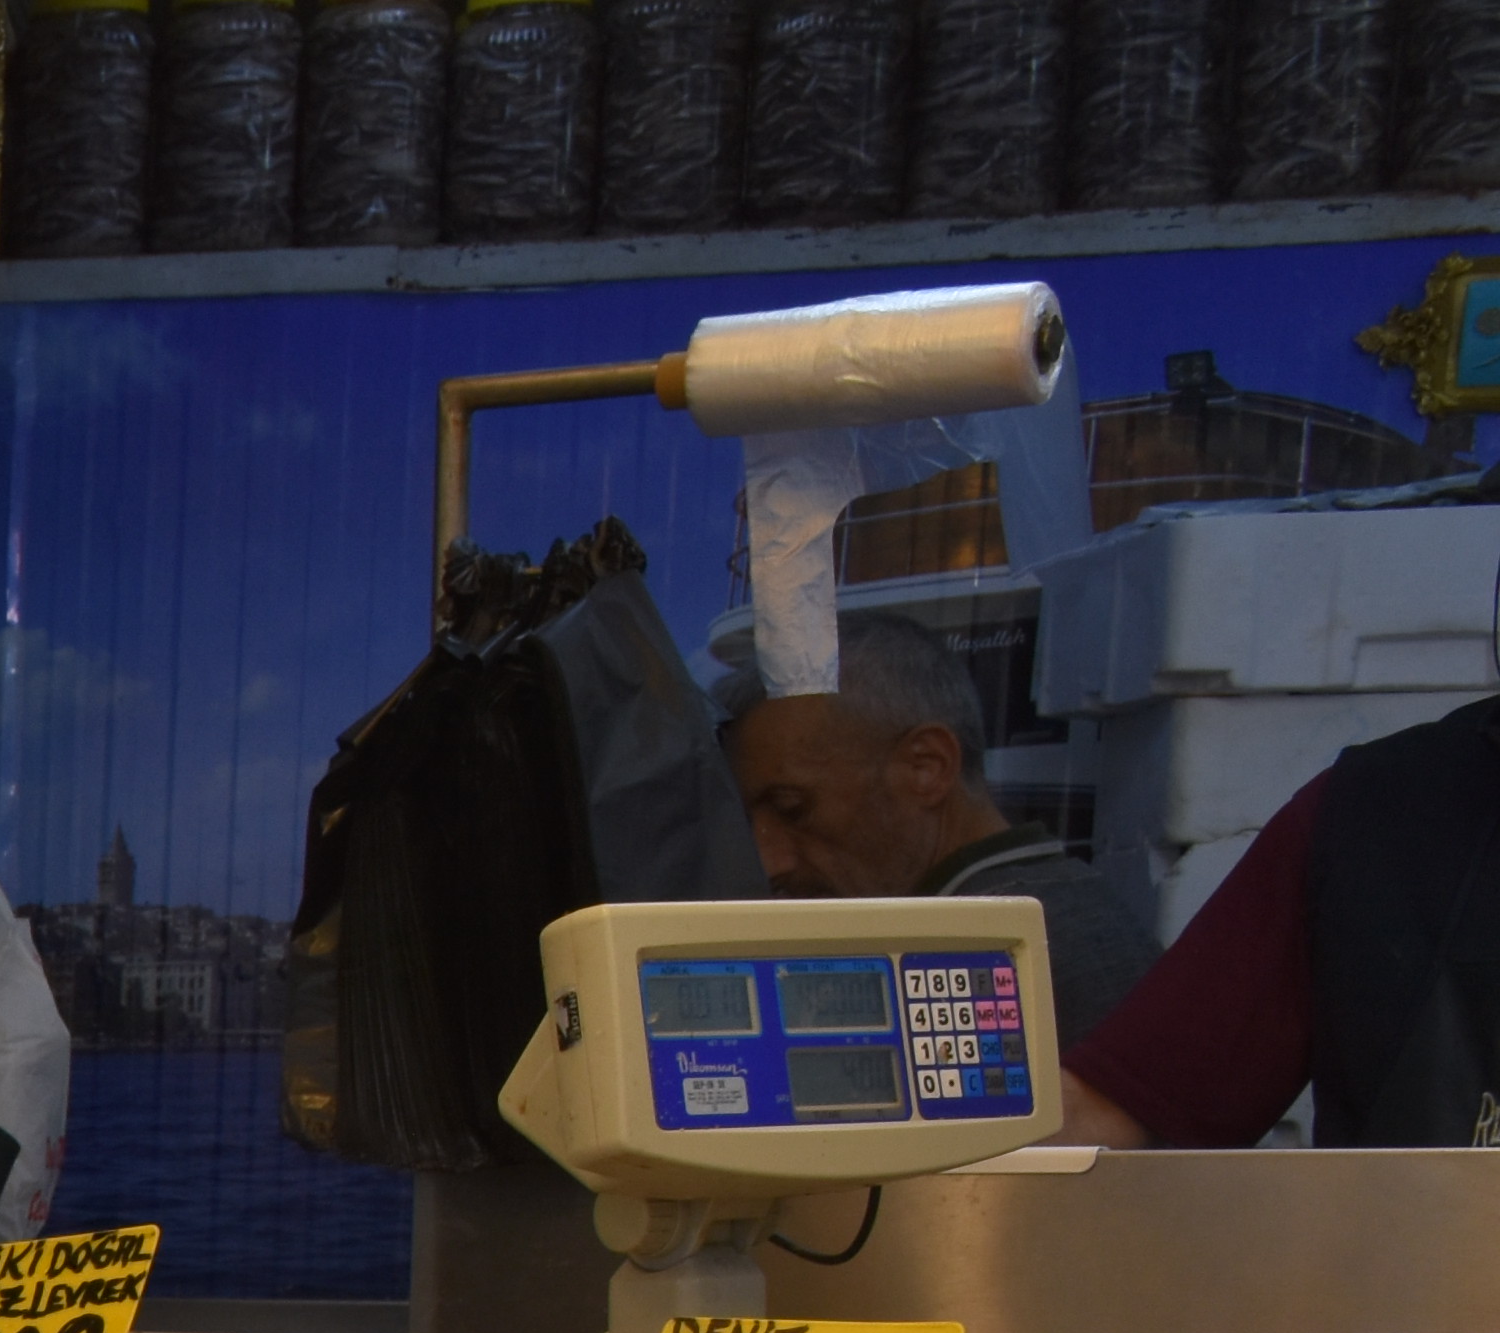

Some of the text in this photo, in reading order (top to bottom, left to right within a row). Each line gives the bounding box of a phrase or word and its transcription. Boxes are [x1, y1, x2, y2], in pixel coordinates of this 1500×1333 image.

[910, 975, 921, 993] 7
[932, 974, 945, 993] 8
[955, 974, 966, 992] 9
[996, 977, 1012, 989] M+
[915, 1007, 1017, 1026] 4 5 6 MR MC
[921, 1042, 930, 1059] 1
[943, 1041, 954, 1059] 2
[964, 1040, 975, 1058] 3
[923, 1075, 935, 1093] 0
[969, 1074, 978, 1092] C
[22, 1270, 148, 1320] LEVREK
